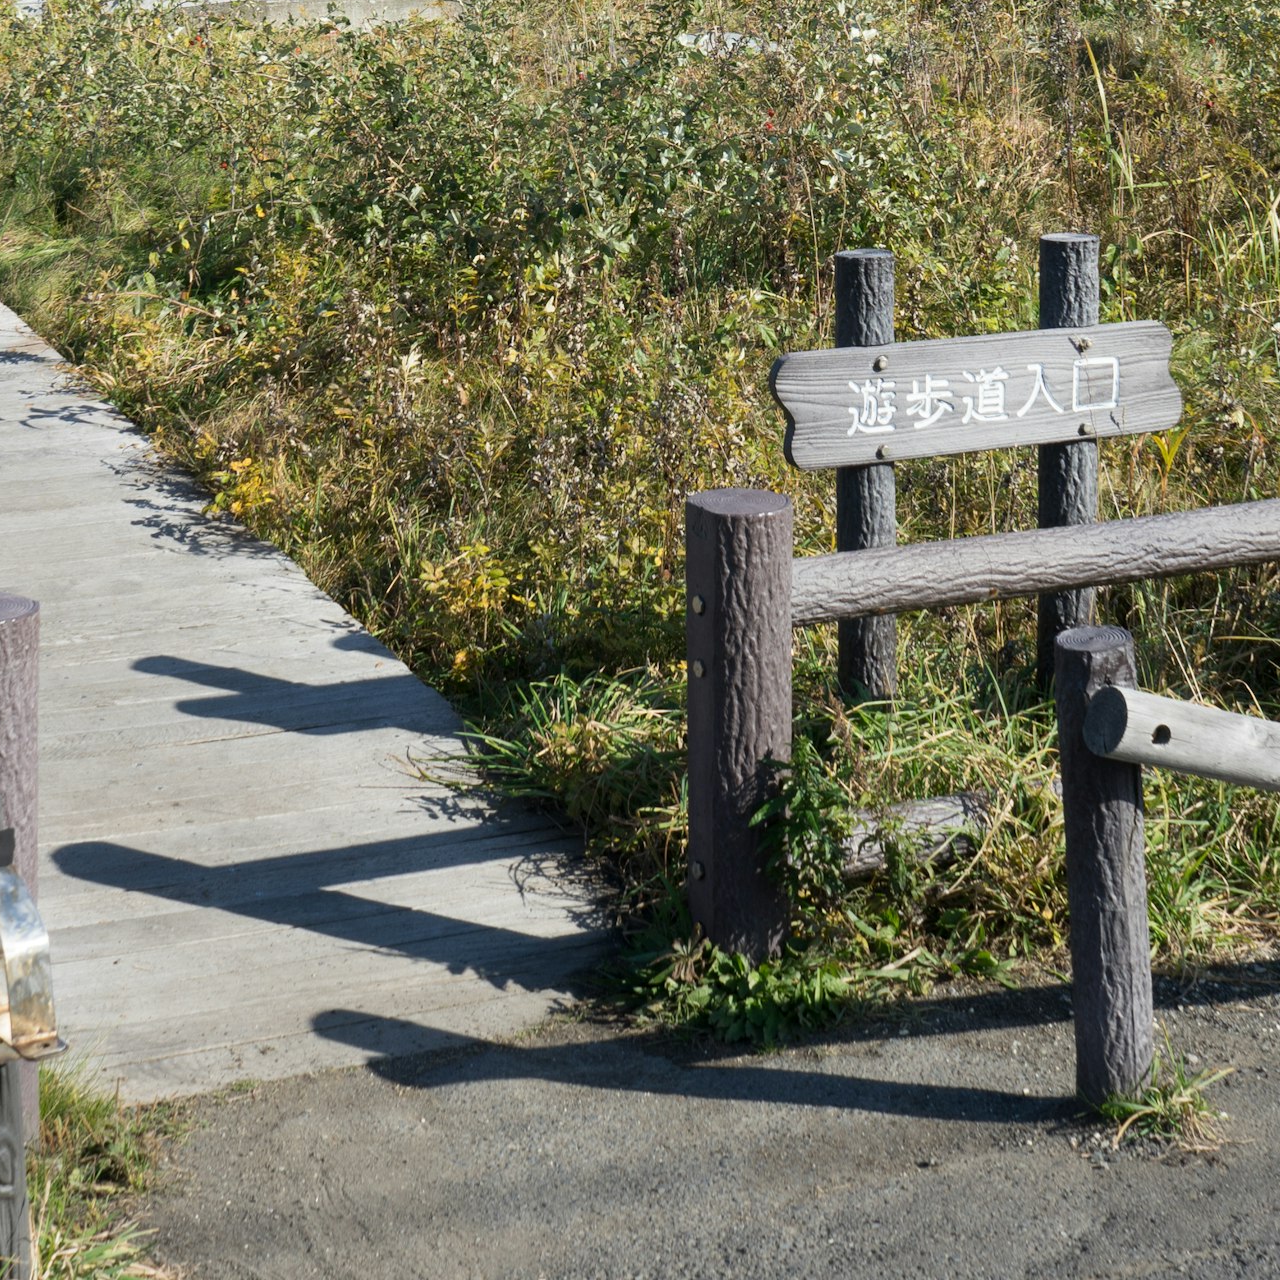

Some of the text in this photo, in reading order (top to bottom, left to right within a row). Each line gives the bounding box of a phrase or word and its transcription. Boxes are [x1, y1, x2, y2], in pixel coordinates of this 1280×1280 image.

[846, 356, 1120, 437] 遊歩道入口
